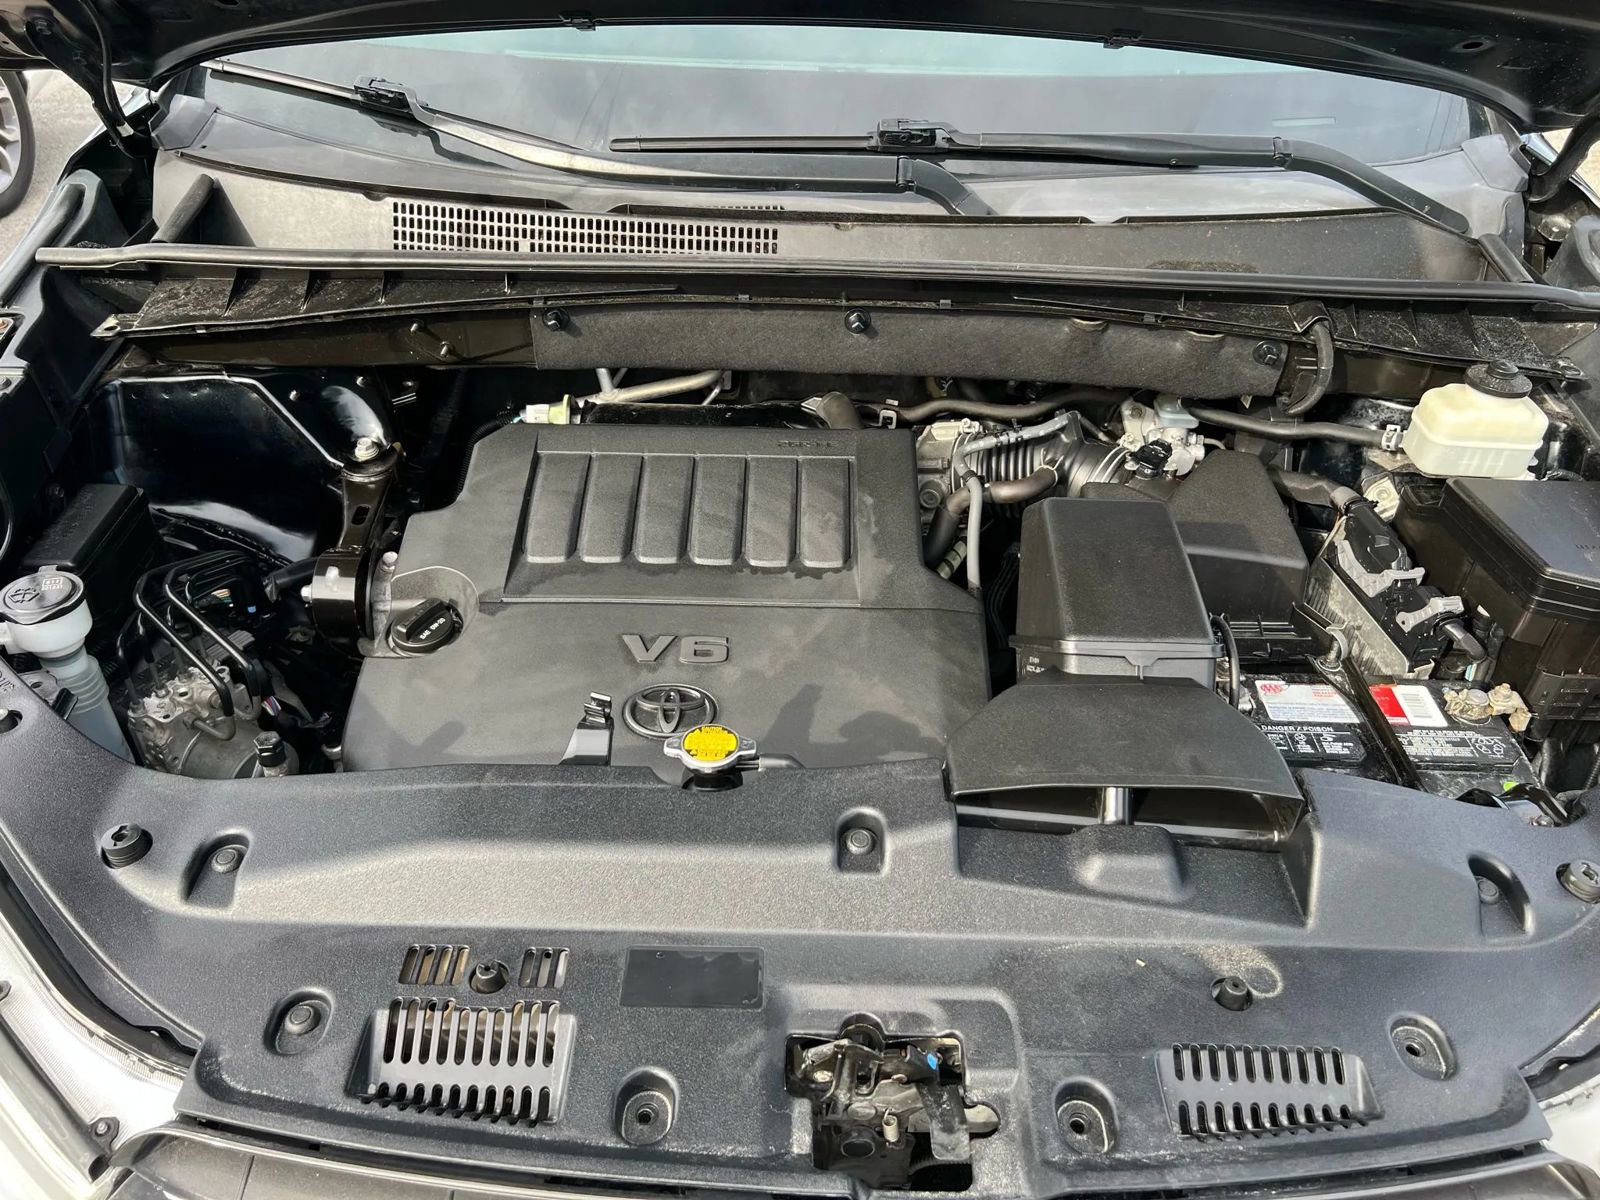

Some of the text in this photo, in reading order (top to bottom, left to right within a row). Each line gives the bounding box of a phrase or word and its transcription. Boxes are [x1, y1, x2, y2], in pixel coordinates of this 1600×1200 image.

[621, 634, 729, 664] V6
[1261, 724, 1295, 732] DANGER
[1303, 725, 1334, 733] POISON
